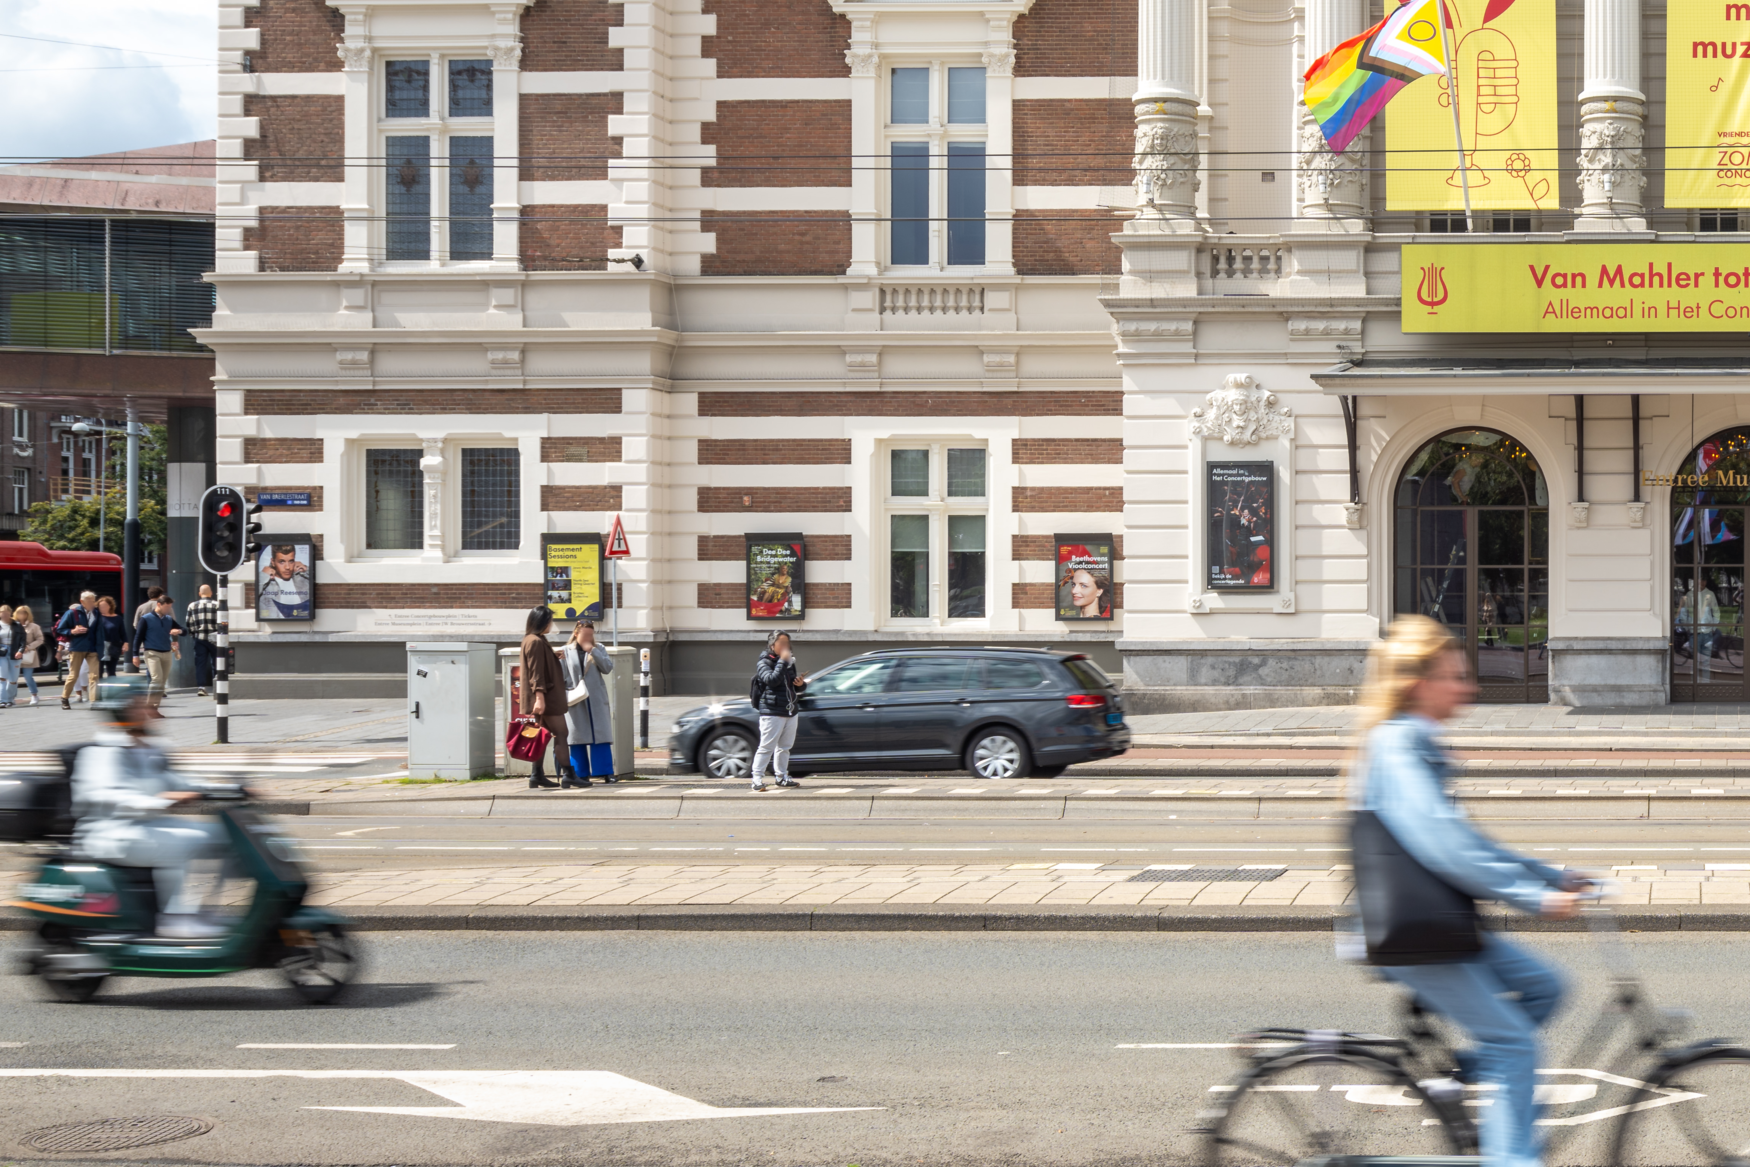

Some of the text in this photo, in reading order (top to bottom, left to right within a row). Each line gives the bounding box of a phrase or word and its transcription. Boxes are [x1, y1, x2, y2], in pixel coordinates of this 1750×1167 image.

[1527, 264, 1587, 290] Van
[1597, 261, 1706, 289] Mahler
[1542, 298, 1634, 320] Allemaal
[1641, 300, 1658, 319] in
[1666, 299, 1702, 319] Het
[1641, 470, 1709, 487] Entree
[757, 556, 797, 564] Bridgewater
